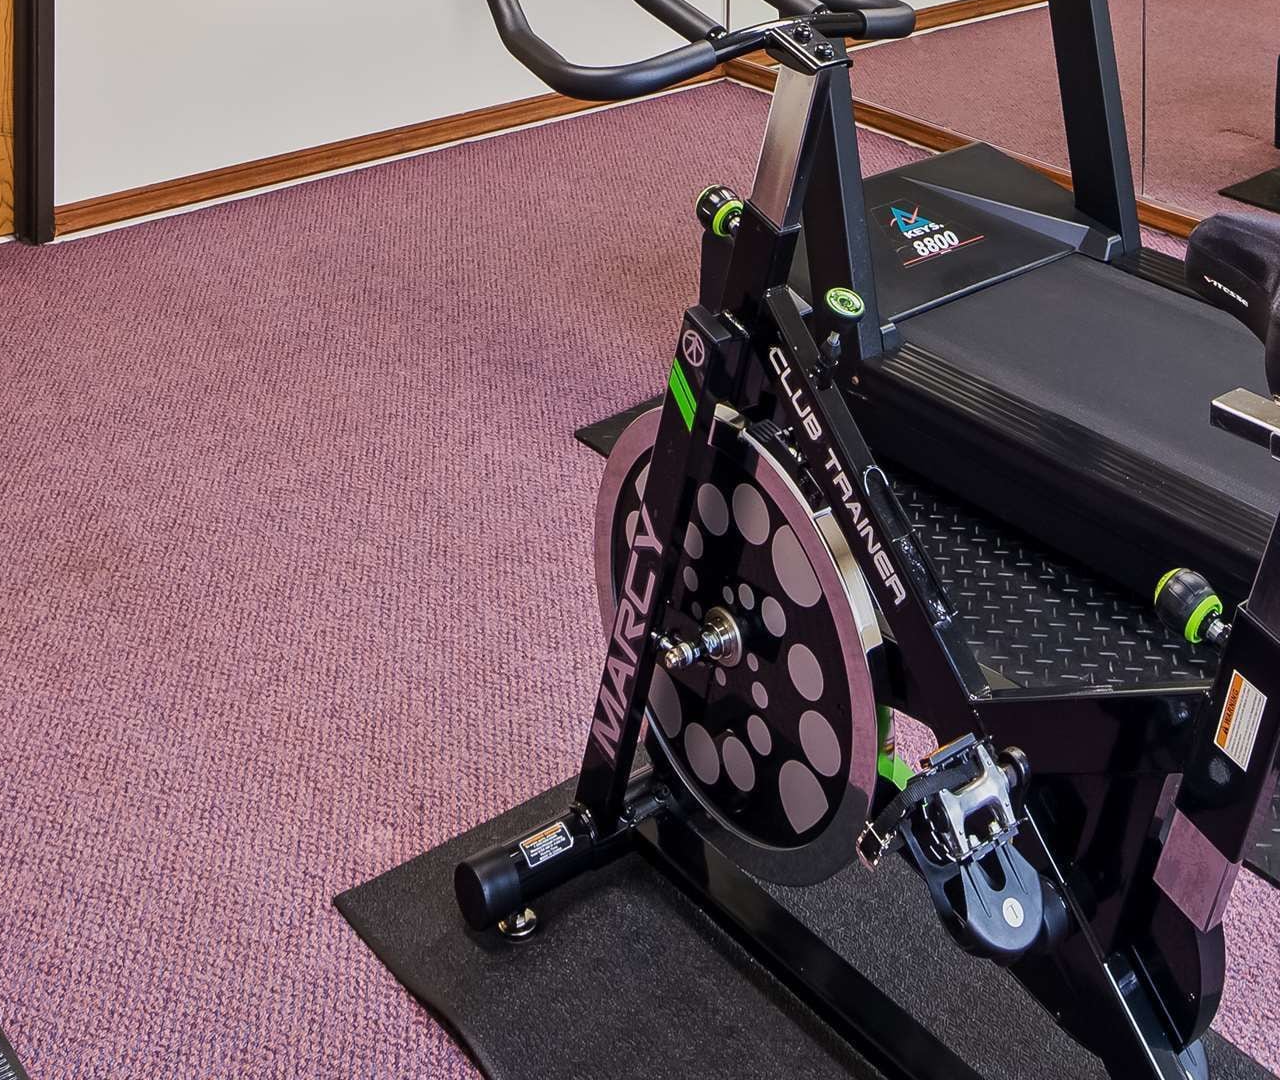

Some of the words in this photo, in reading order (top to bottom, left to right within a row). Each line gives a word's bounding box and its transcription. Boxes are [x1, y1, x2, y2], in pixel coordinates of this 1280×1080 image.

[912, 230, 961, 257] 8800
[768, 345, 824, 443] CLUB
[824, 445, 909, 608] TRAINER
[590, 502, 667, 760] MARCY
[1223, 688, 1240, 726] WARNING
